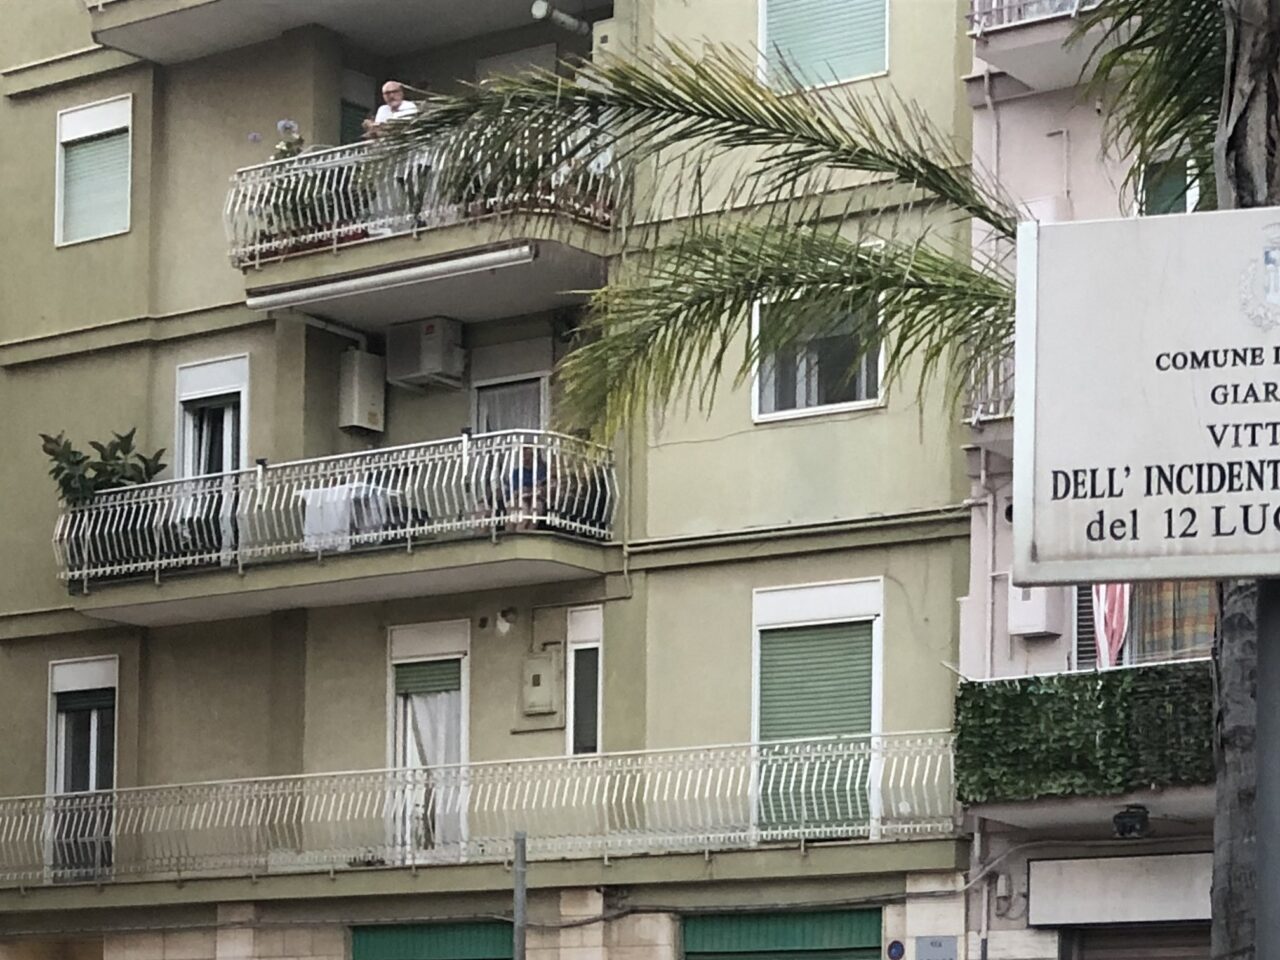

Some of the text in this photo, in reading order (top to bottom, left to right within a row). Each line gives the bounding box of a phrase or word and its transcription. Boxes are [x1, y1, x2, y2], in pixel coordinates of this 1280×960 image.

[1155, 347, 1265, 371] COMUNE
[1052, 465, 1131, 501] DELL'
[1086, 508, 1139, 542] del
[1164, 507, 1198, 539] 12
